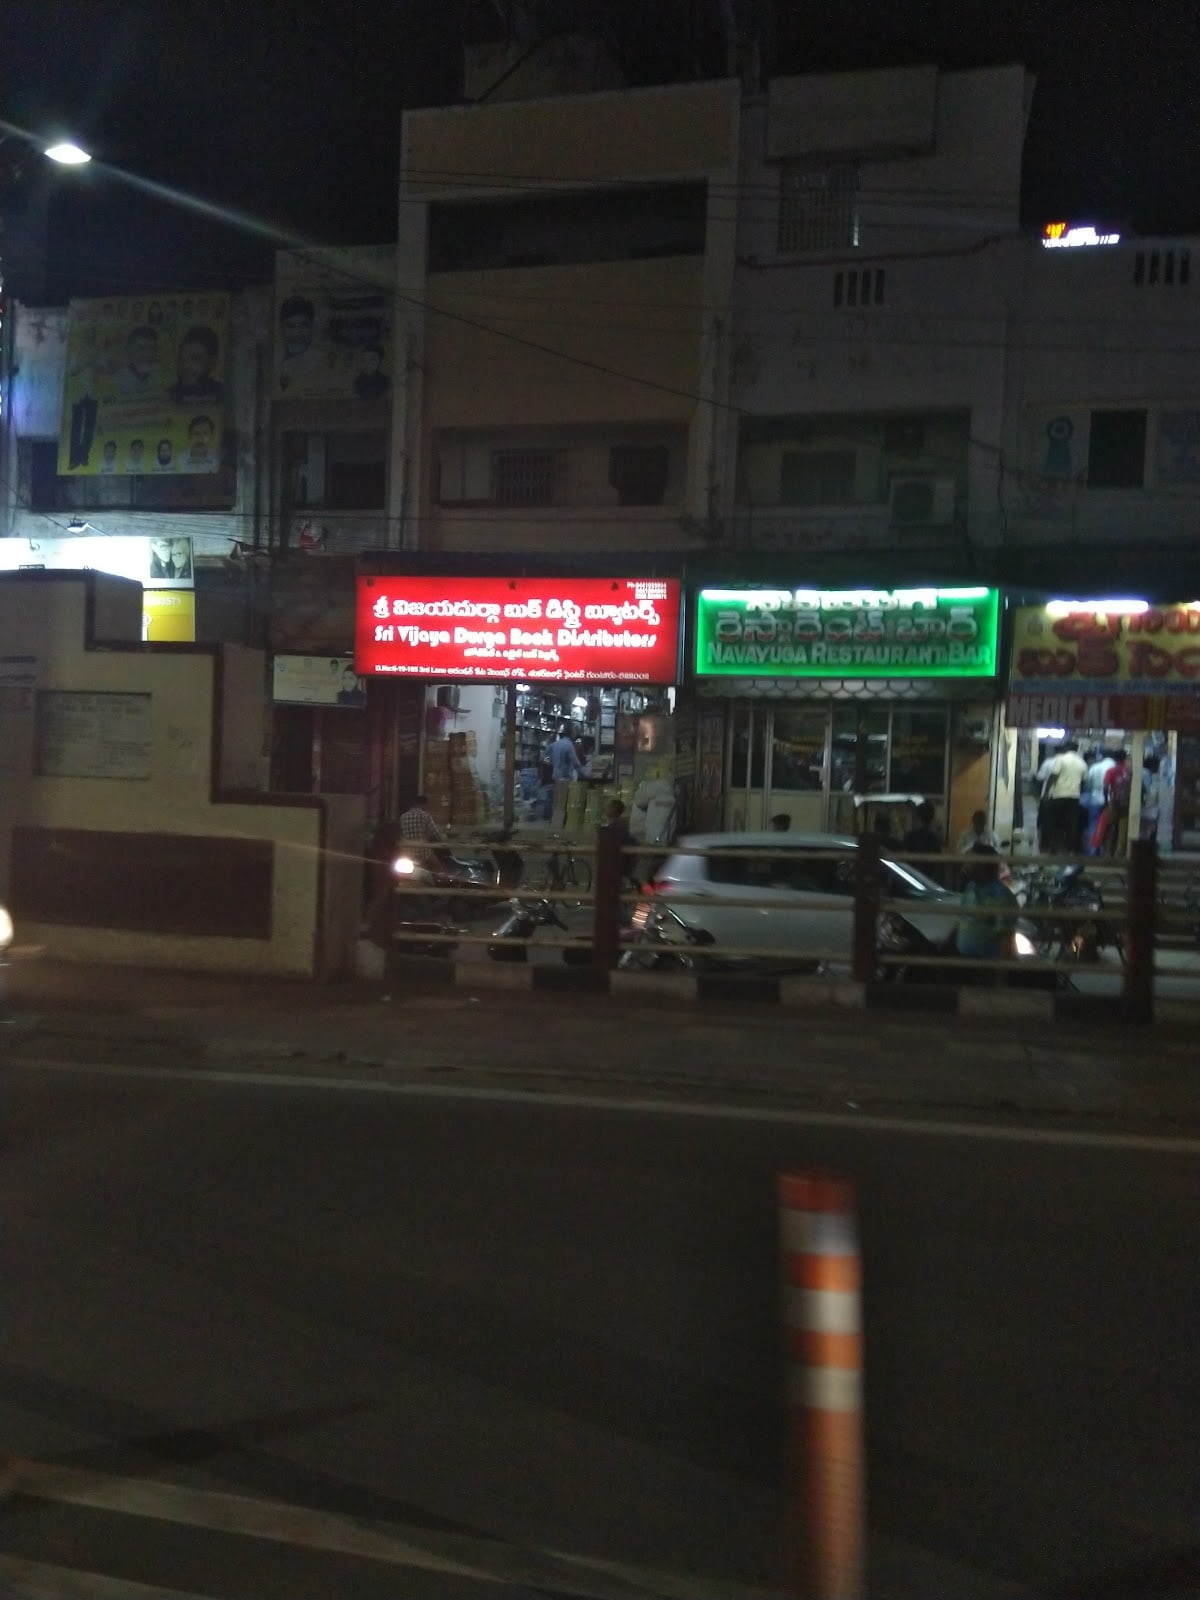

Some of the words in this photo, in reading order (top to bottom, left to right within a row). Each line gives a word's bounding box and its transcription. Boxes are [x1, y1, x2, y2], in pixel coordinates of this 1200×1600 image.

[374, 625, 394, 642] Sri
[397, 625, 451, 647] Vijaya
[454, 627, 507, 648] Durga
[510, 628, 554, 646] Book
[557, 628, 657, 648] Distributors
[707, 643, 808, 664] NAVAYUGA
[811, 644, 942, 665] RESTAURANT
[948, 640, 991, 665] BAR
[1008, 696, 1115, 728] MEDICAL
